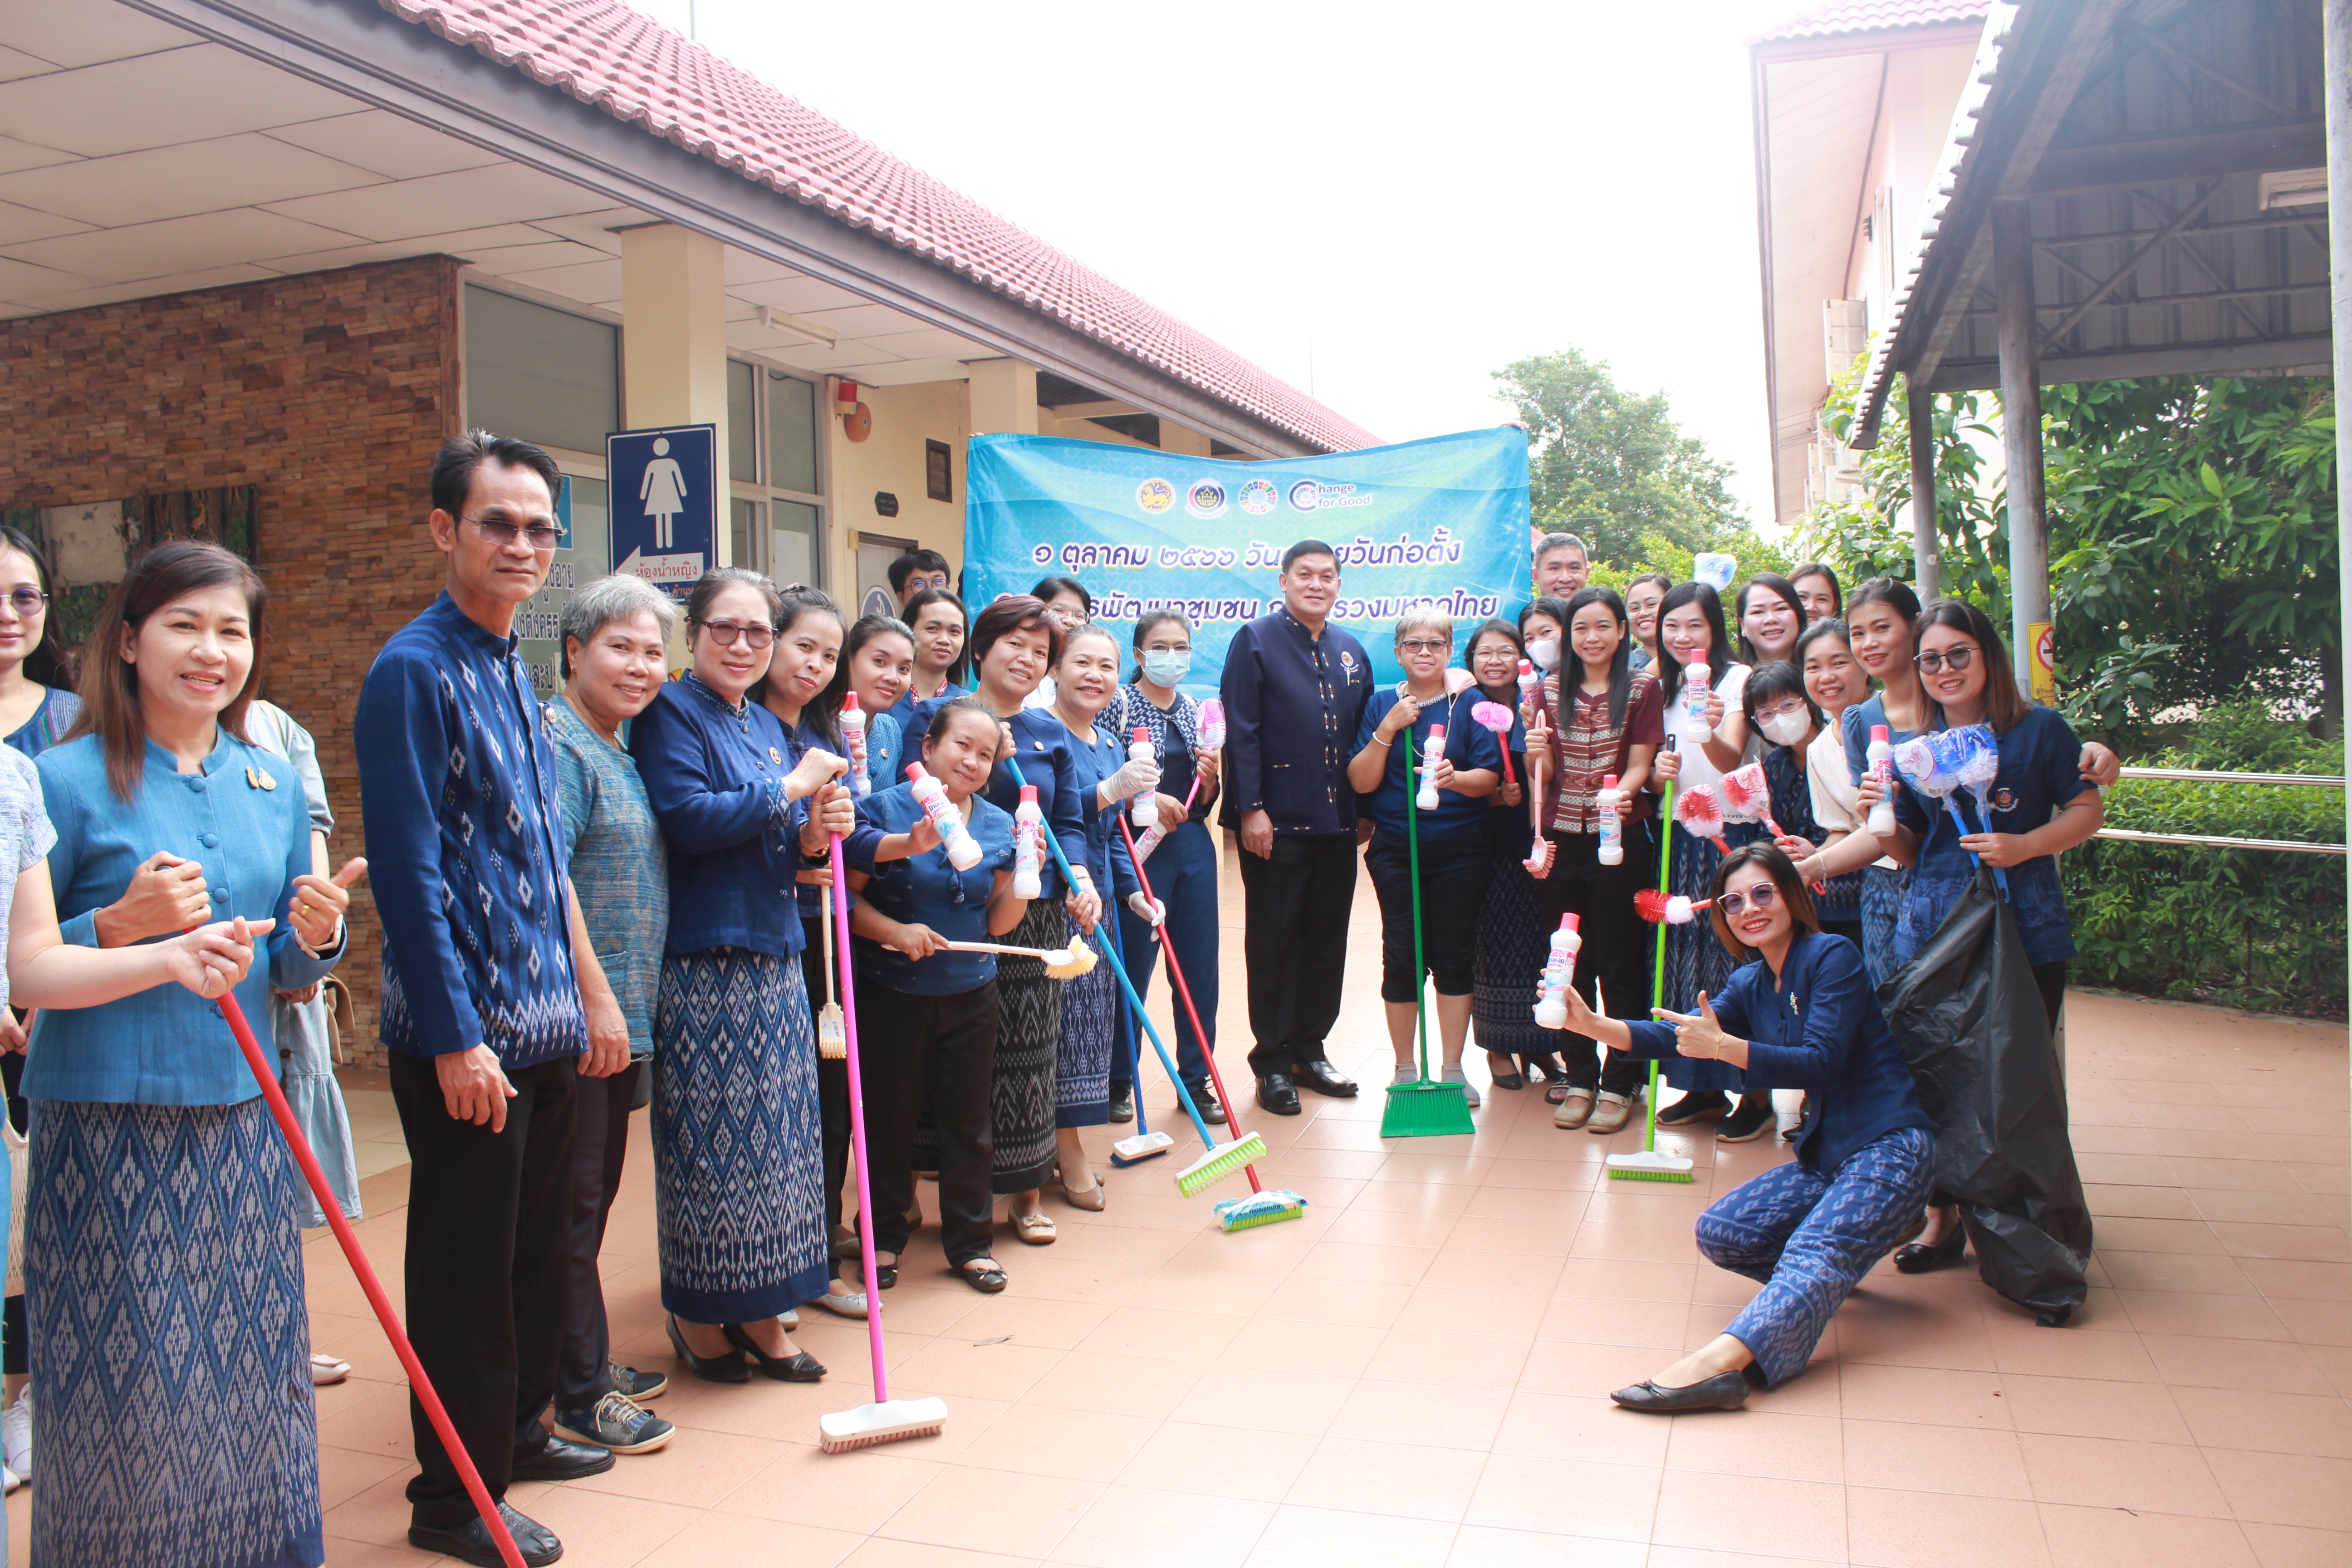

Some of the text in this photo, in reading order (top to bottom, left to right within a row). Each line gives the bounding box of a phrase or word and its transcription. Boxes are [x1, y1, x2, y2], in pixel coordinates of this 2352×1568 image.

[1318, 495, 1370, 507] for Good
[1062, 544, 1149, 572] ตุลาคม
[1160, 546, 1235, 566] ๒๕๖๖
[1245, 528, 1460, 566] วันยวันก่อตั้ง
[635, 557, 697, 579] ห้องน้ำหญิง
